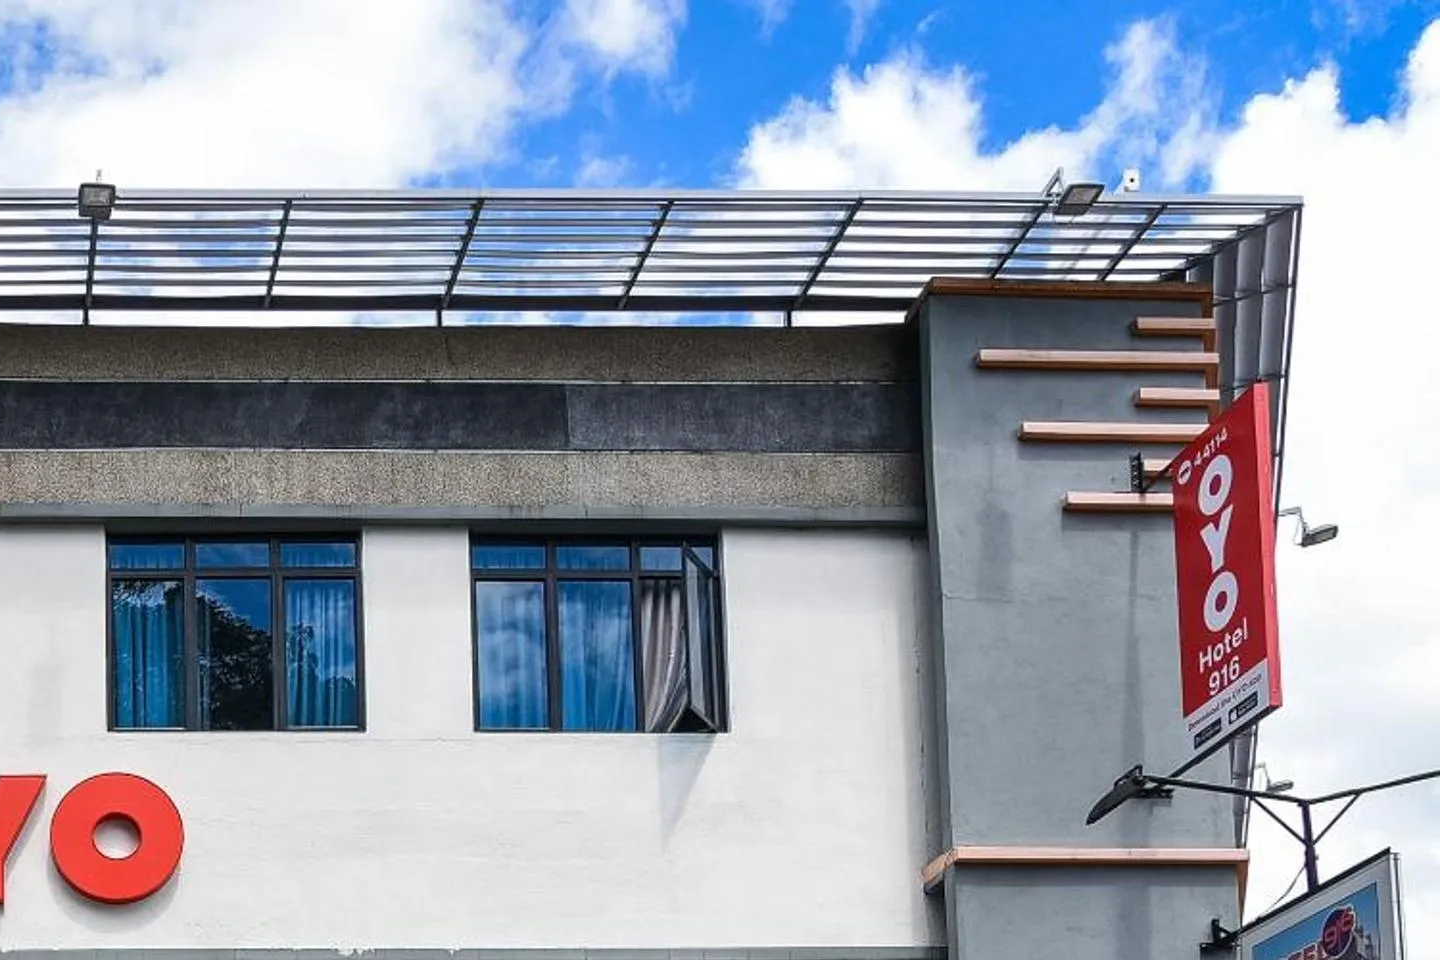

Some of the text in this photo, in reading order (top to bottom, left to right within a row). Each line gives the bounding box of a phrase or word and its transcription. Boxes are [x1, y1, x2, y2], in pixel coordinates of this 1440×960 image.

[1198, 454, 1239, 632] OYO
[1199, 617, 1248, 674] Hotel
[1209, 656, 1240, 696] 916
